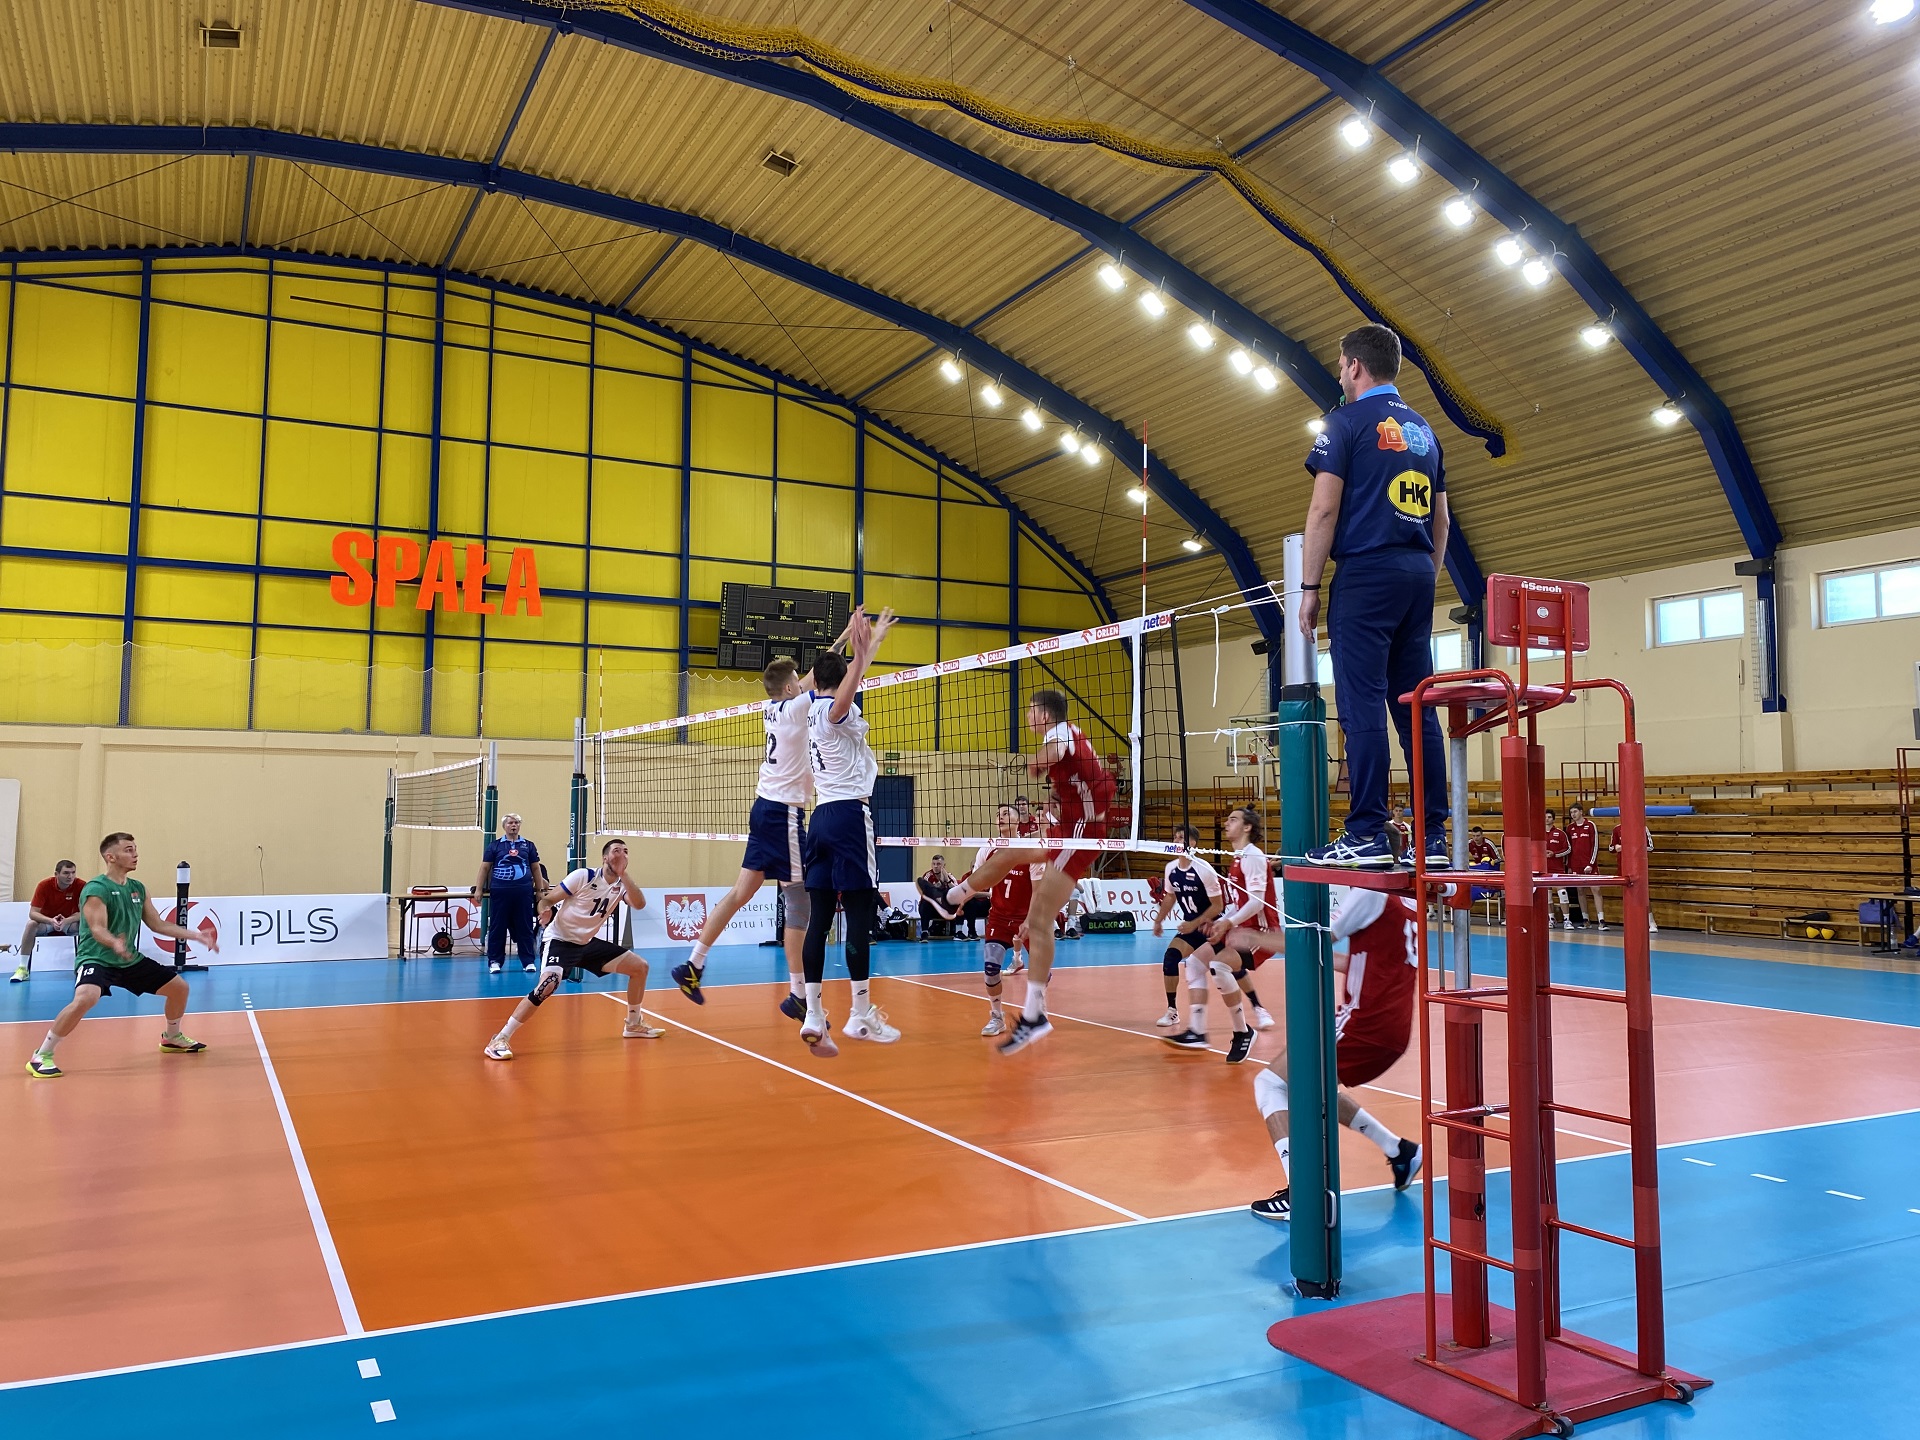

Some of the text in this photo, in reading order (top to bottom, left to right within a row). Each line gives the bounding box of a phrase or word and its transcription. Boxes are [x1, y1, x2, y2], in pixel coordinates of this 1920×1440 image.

[1399, 480, 1429, 508] HK
[330, 531, 543, 617] SPAŁA
[1528, 582, 1562, 593] Senoh
[1142, 613, 1172, 631] netex
[1095, 624, 1120, 641] ORLEN
[1038, 638, 1060, 653] ORLEN
[987, 650, 1007, 663] ORLEN
[902, 669, 918, 681] ORLEN
[943, 660, 960, 673] ORLEN
[866, 677, 881, 688] ORLEN
[1003, 878, 1012, 899] 7
[590, 897, 610, 918] 14
[1181, 895, 1199, 914] 14
[178, 897, 188, 954] DAROL
[239, 907, 339, 946] PLS
[1088, 920, 1132, 930] BLACKROLL
[83, 967, 94, 976] 13
